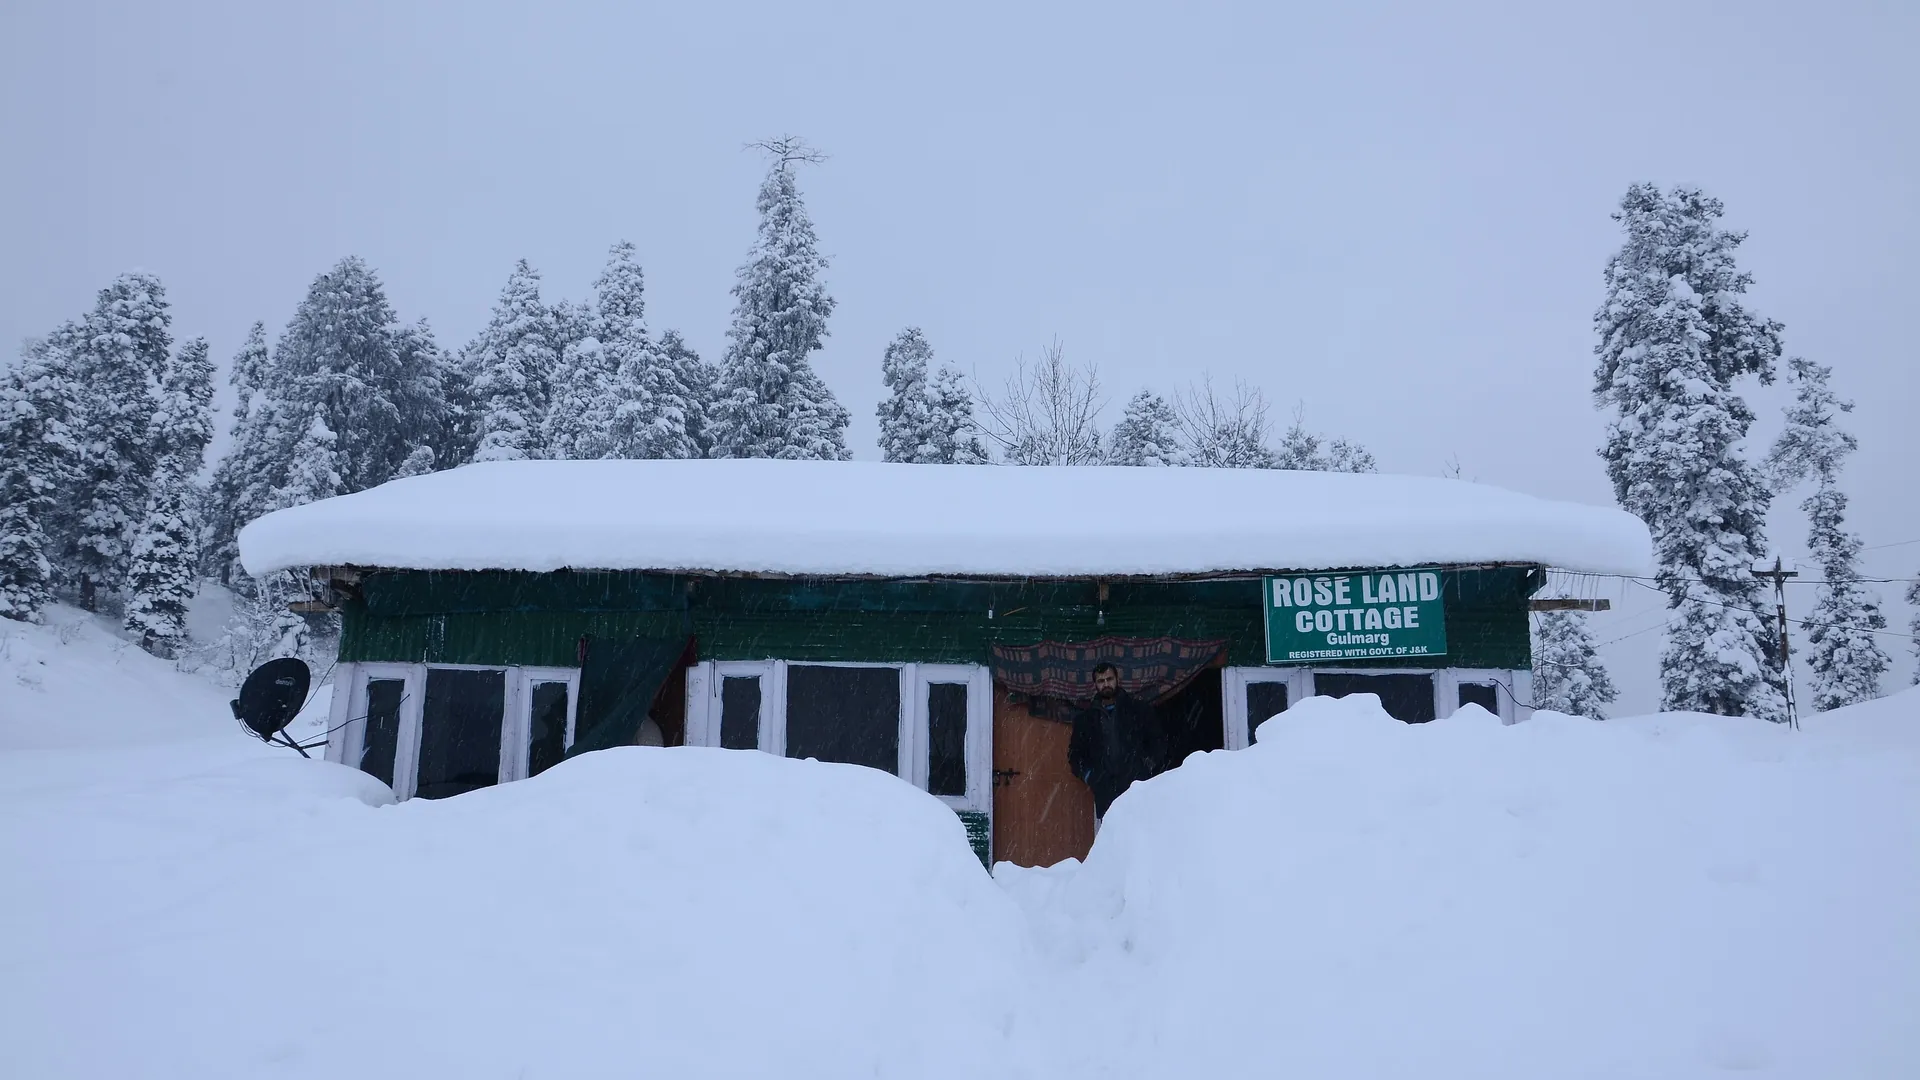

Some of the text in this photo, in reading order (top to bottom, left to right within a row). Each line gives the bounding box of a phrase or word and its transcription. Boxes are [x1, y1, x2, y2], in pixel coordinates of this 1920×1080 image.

[1272, 572, 1439, 607] ROSE LAND
[1295, 606, 1420, 633] COTTAGE
[1326, 632, 1390, 646] Gulmarg
[1289, 645, 1428, 659] REGISTERED WITH GOVT. OF J&K
